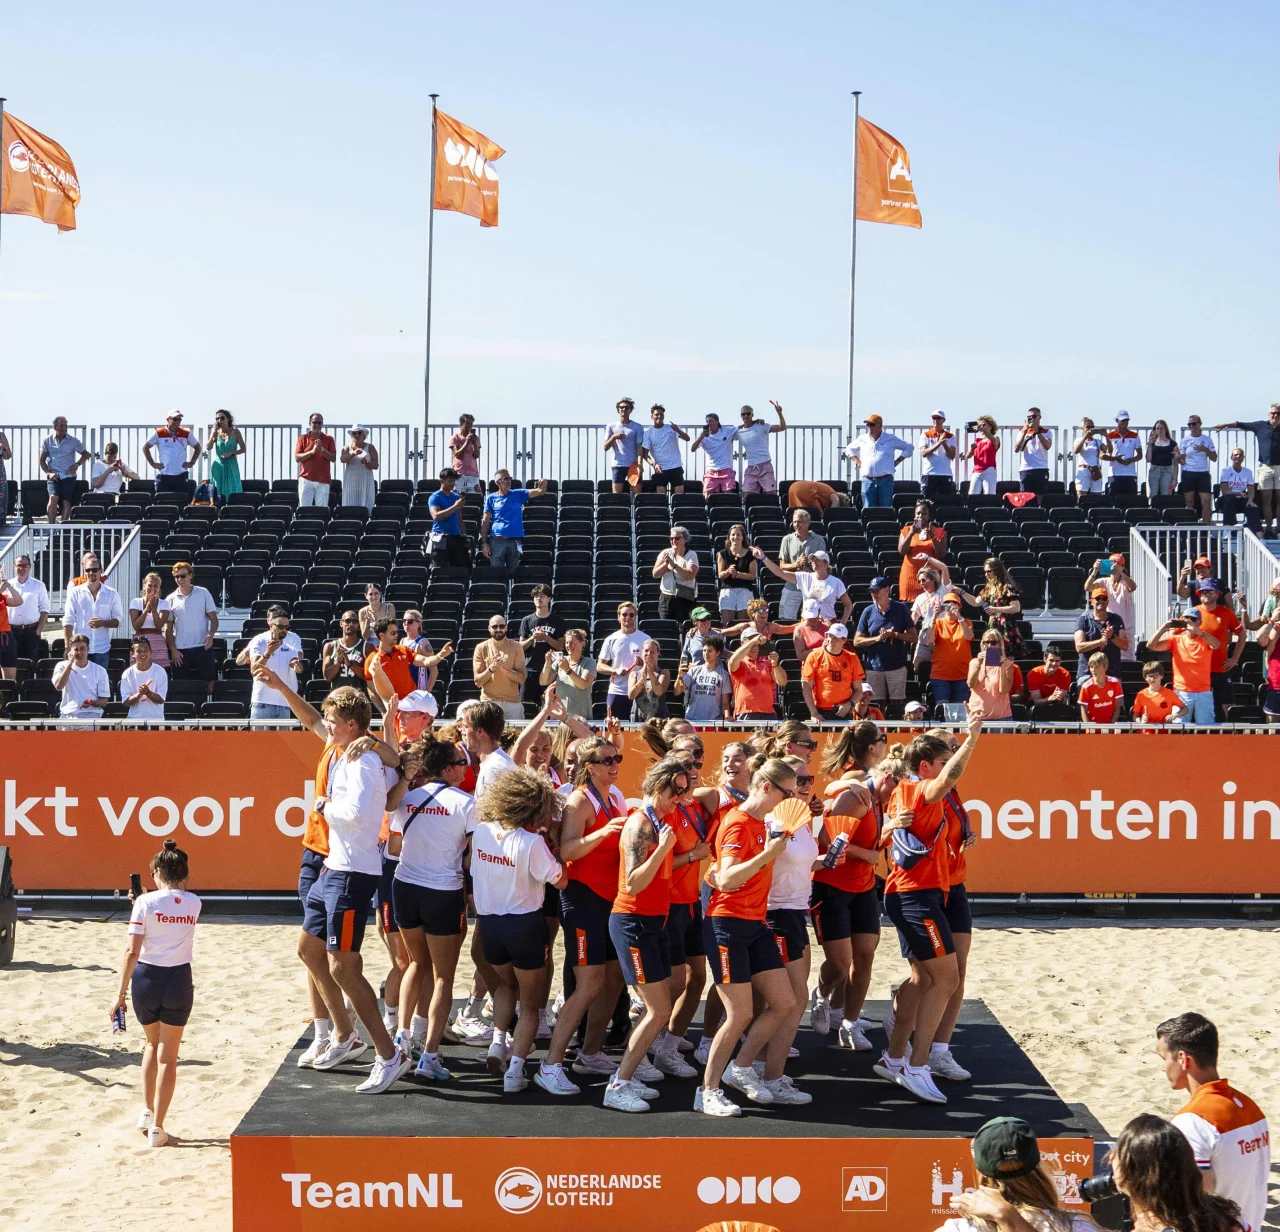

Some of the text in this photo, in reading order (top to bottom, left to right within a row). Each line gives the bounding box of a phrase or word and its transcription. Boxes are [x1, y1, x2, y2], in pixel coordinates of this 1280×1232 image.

[340, 663, 355, 677] 34
[97, 796, 254, 837] voor
[477, 849, 516, 867] TeamNL
[929, 925, 941, 949] TeamNL
[631, 952, 643, 976] TeamNL
[721, 952, 729, 976] TeamNL
[1039, 1150, 1090, 1166] ost city
[281, 1173, 463, 1208] TeamNL
[546, 1174, 662, 1189] NEDERLANDSE
[844, 1175, 885, 1201] AD
[546, 1191, 613, 1206] LOTERIJ
